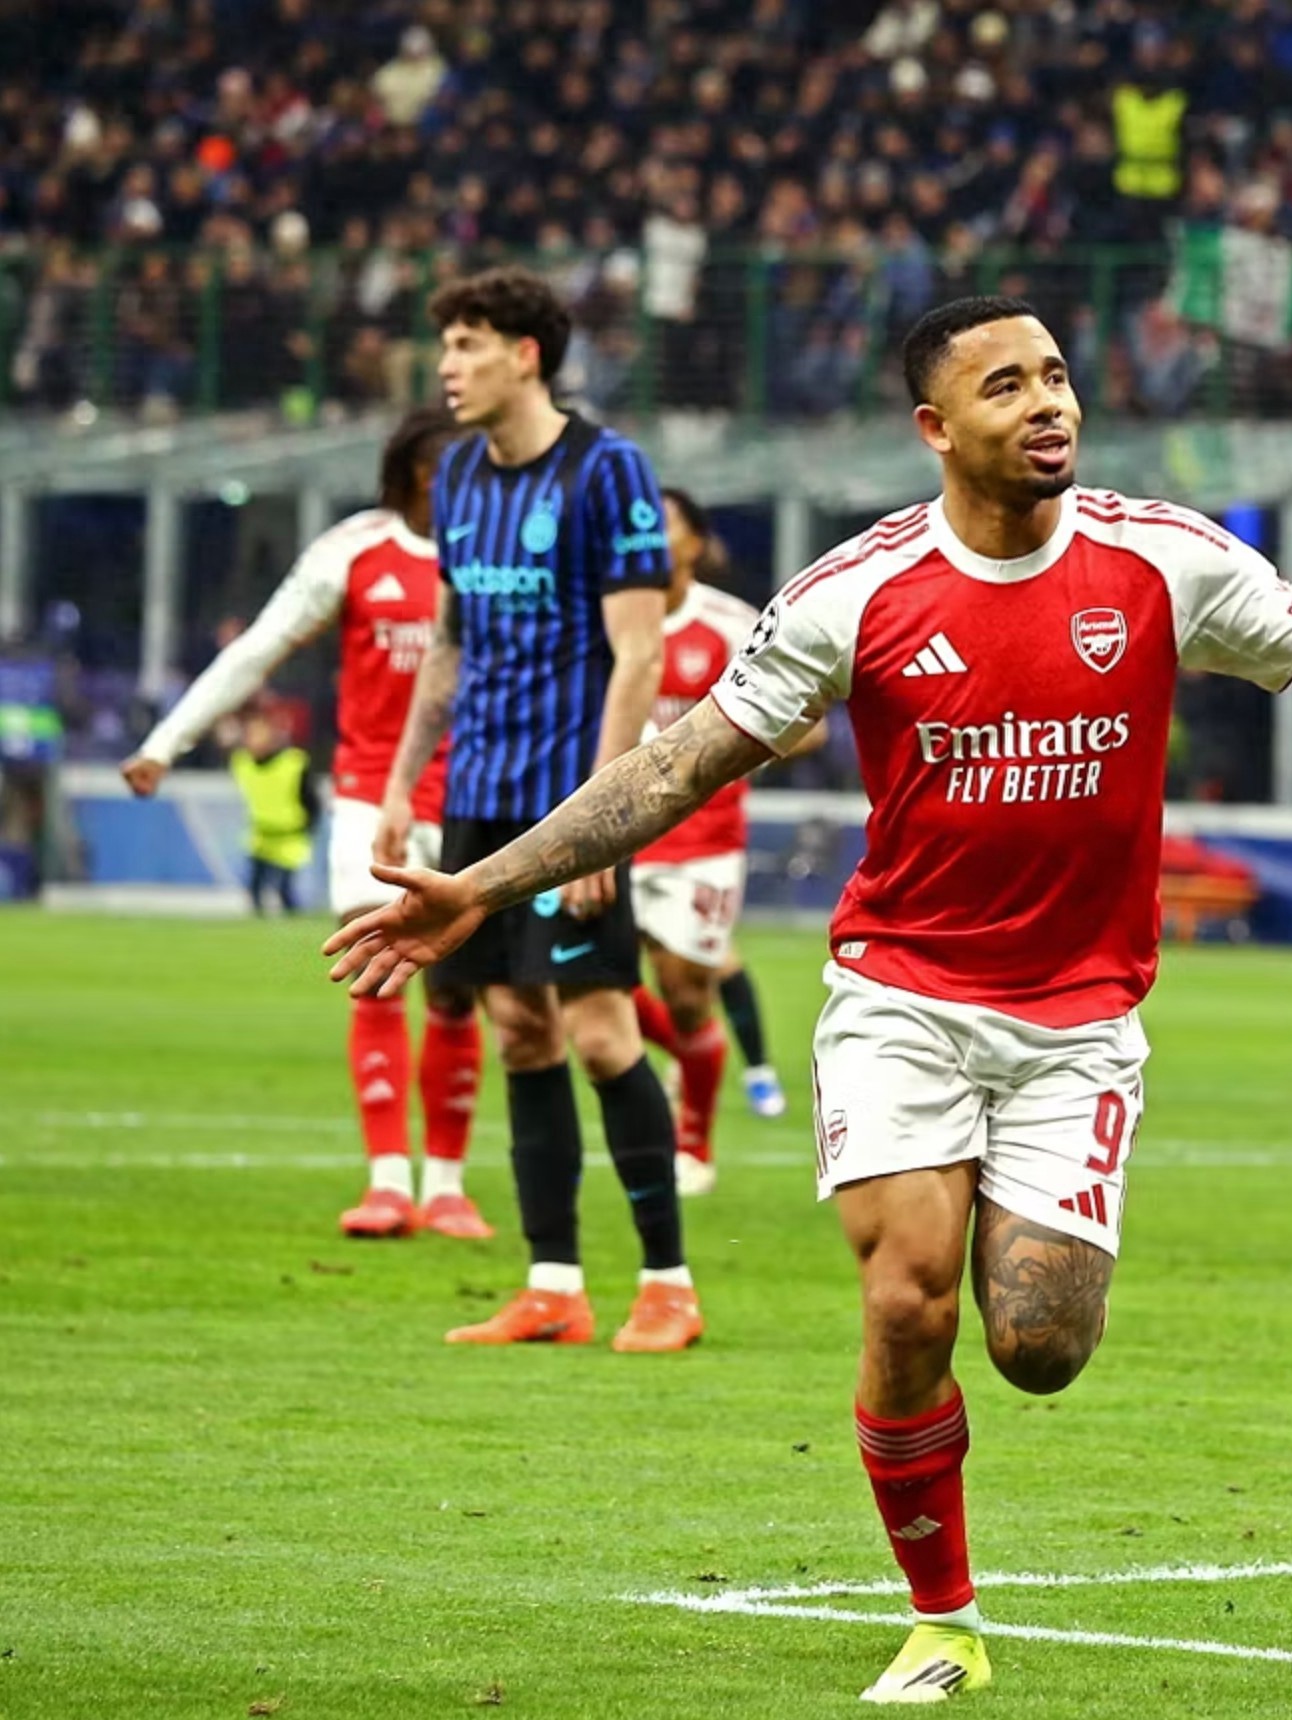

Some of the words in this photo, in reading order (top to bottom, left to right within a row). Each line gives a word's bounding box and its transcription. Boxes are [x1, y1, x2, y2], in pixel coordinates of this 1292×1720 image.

[915, 711, 1129, 764] Emirates
[946, 767, 994, 803] FLY
[1002, 760, 1101, 803] BETTER
[1085, 1089, 1127, 1176] 9
